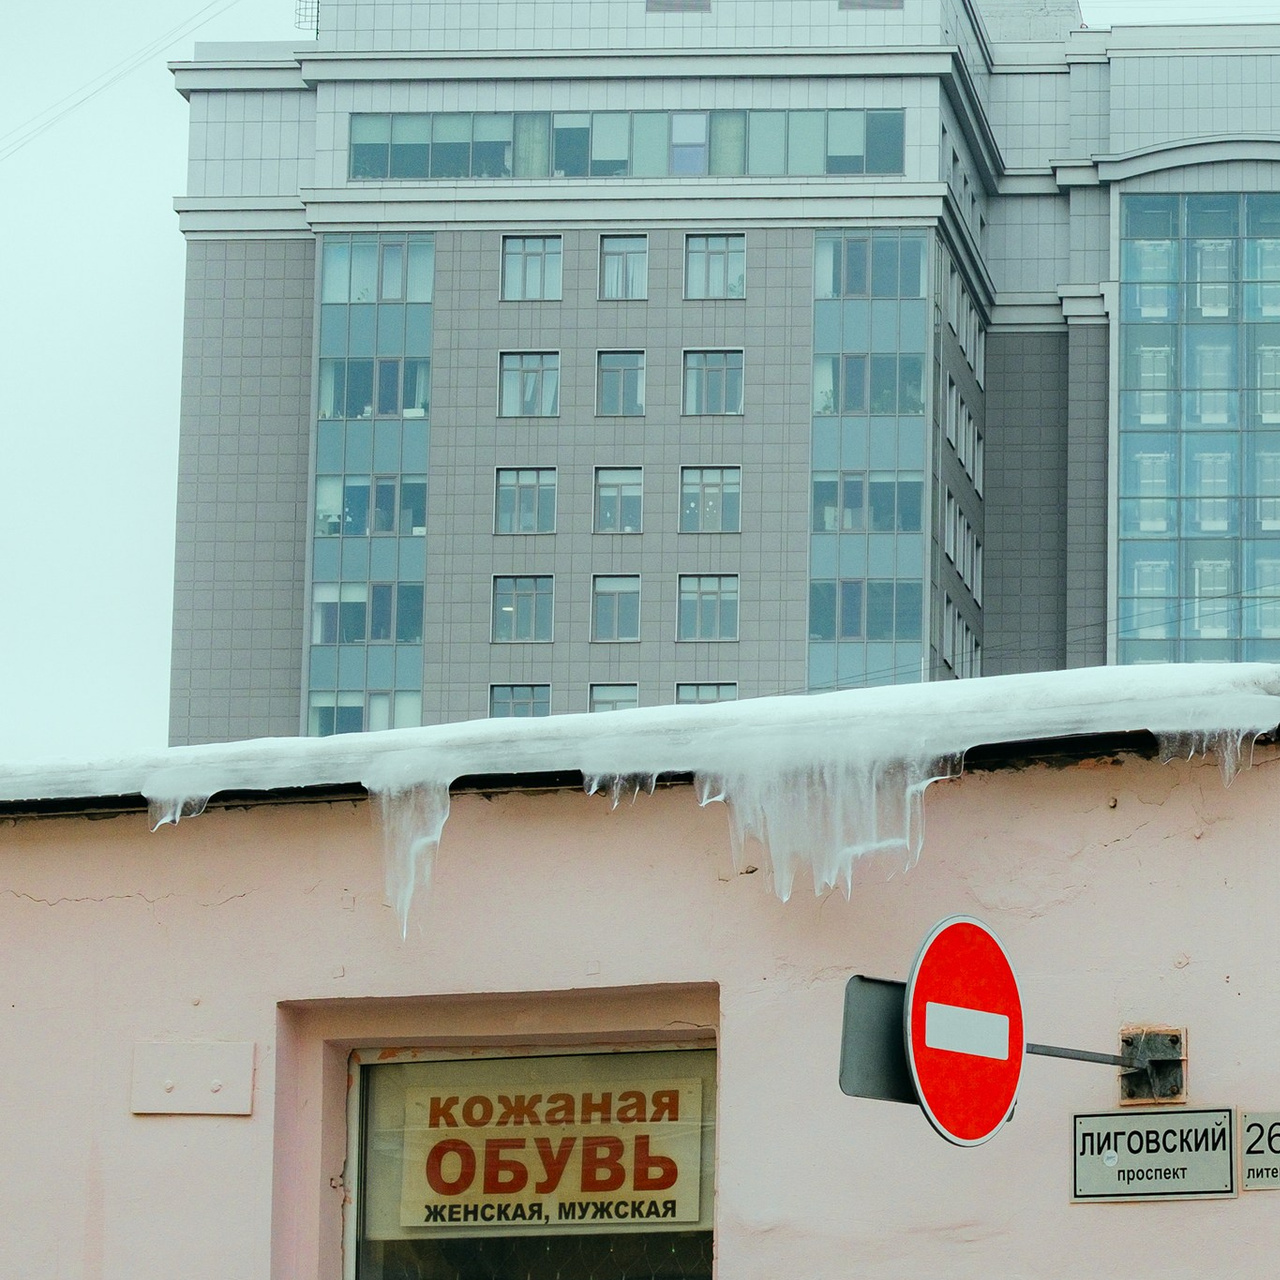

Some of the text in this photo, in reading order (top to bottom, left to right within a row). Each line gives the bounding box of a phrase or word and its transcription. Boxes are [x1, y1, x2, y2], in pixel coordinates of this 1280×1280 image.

[428, 1089, 680, 1129] кожаная
[1079, 1121, 1227, 1156] ЛИГОВСКИЙ
[425, 1135, 678, 1196] ОБУВЬ
[1117, 1167, 1188, 1184] проспект
[423, 1199, 677, 1224] ЖЕНСКАЯ, МУЖСКАЯ
